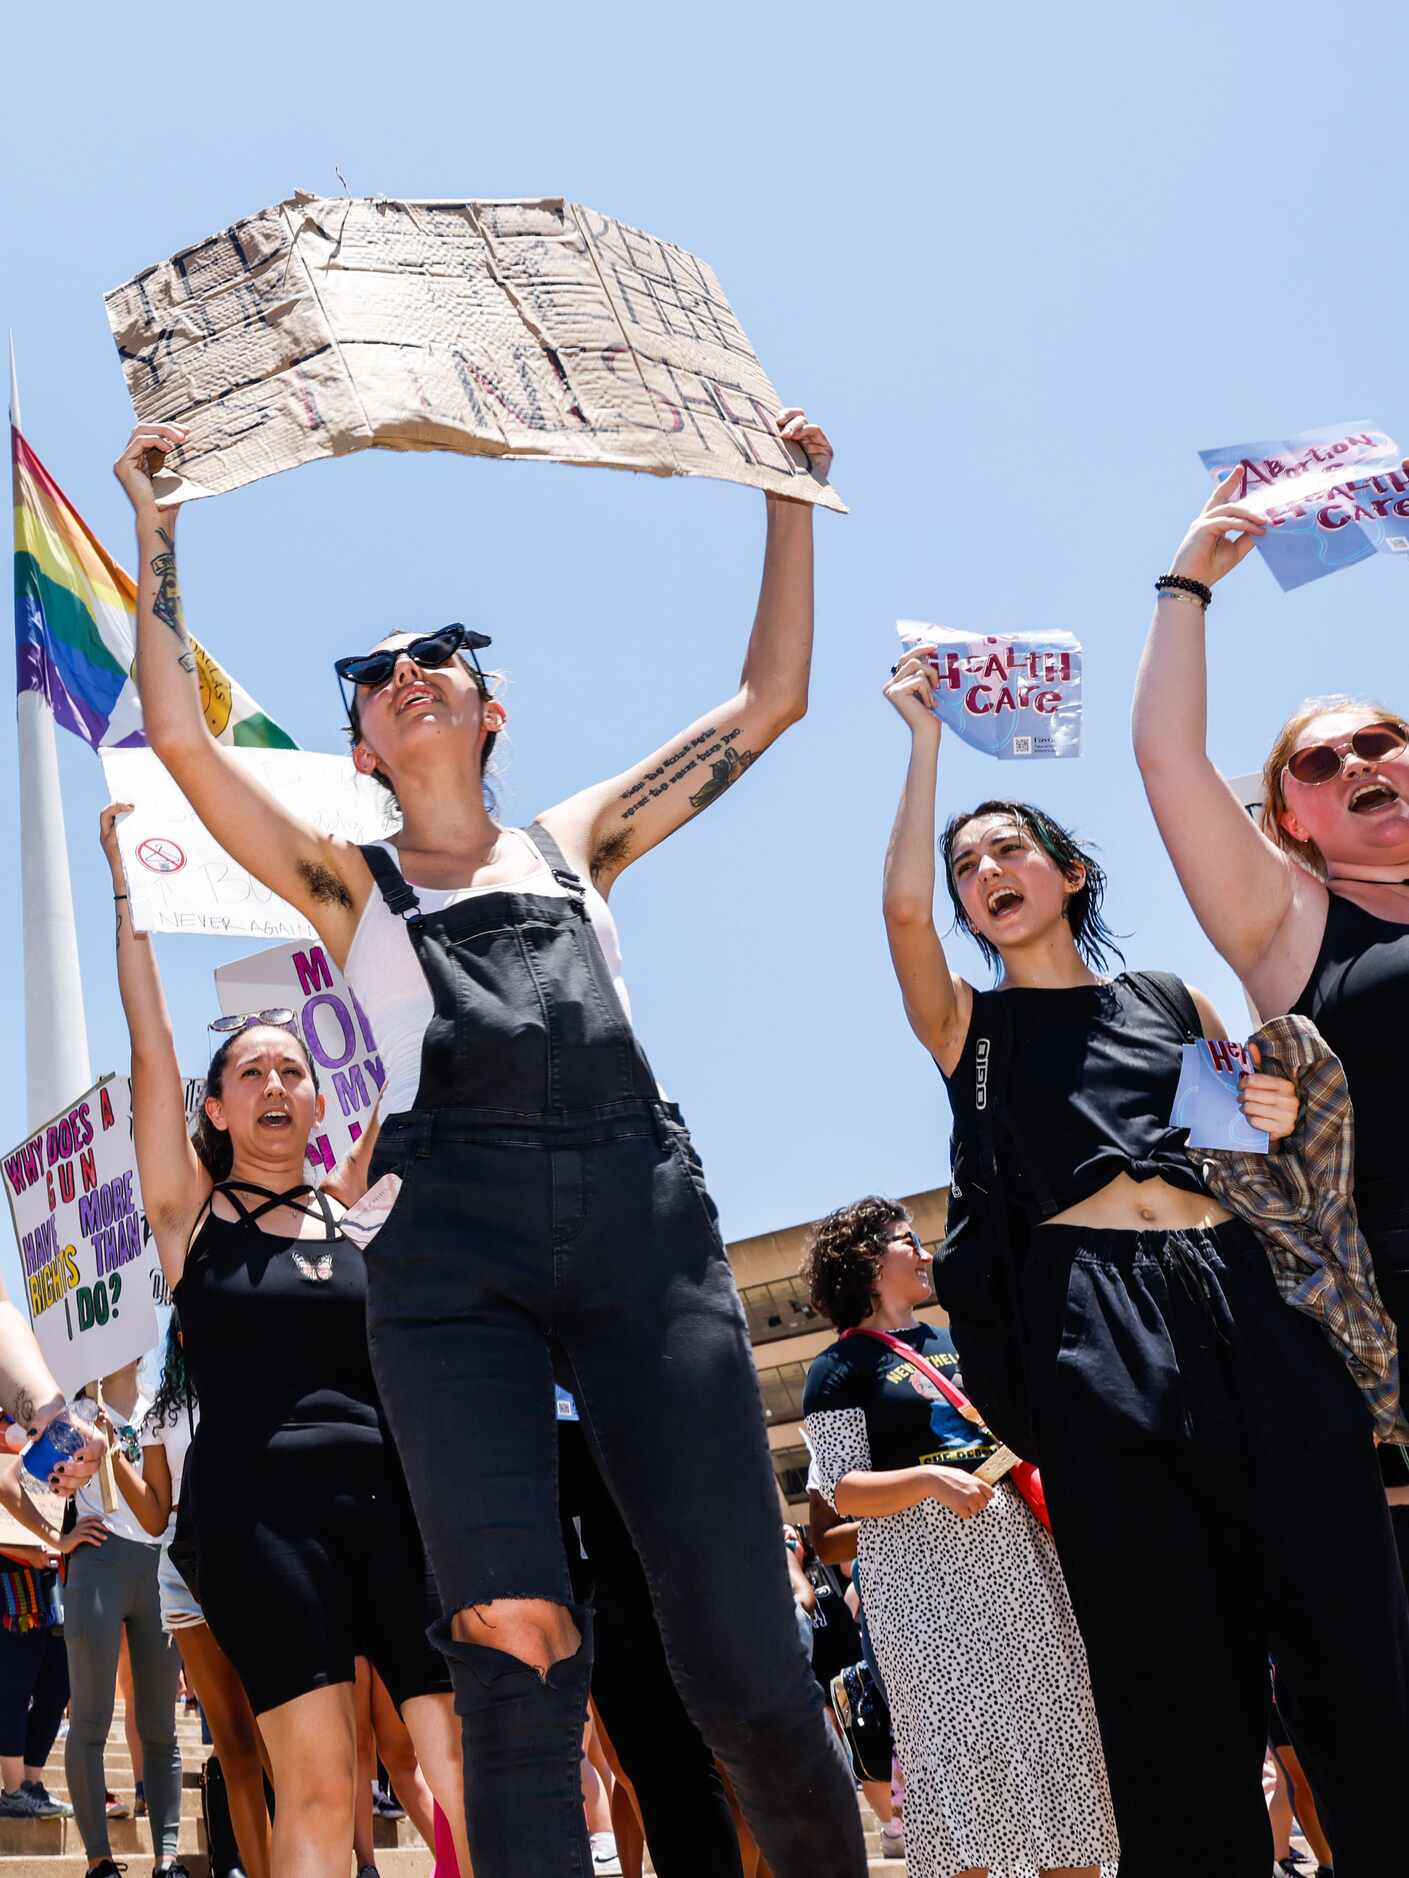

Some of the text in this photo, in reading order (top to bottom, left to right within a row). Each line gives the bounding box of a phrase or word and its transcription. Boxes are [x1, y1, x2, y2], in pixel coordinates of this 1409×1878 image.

[975, 1037, 991, 1110] OGIO
[4, 1134, 43, 1196] WHY
[46, 1102, 94, 1167] DOES
[100, 1086, 115, 1132] A
[22, 1169, 136, 1277] HAVE MORE
[28, 1244, 81, 1319] RIGHTS
[91, 1210, 143, 1278] THAN
[64, 1271, 123, 1341] I DO?
